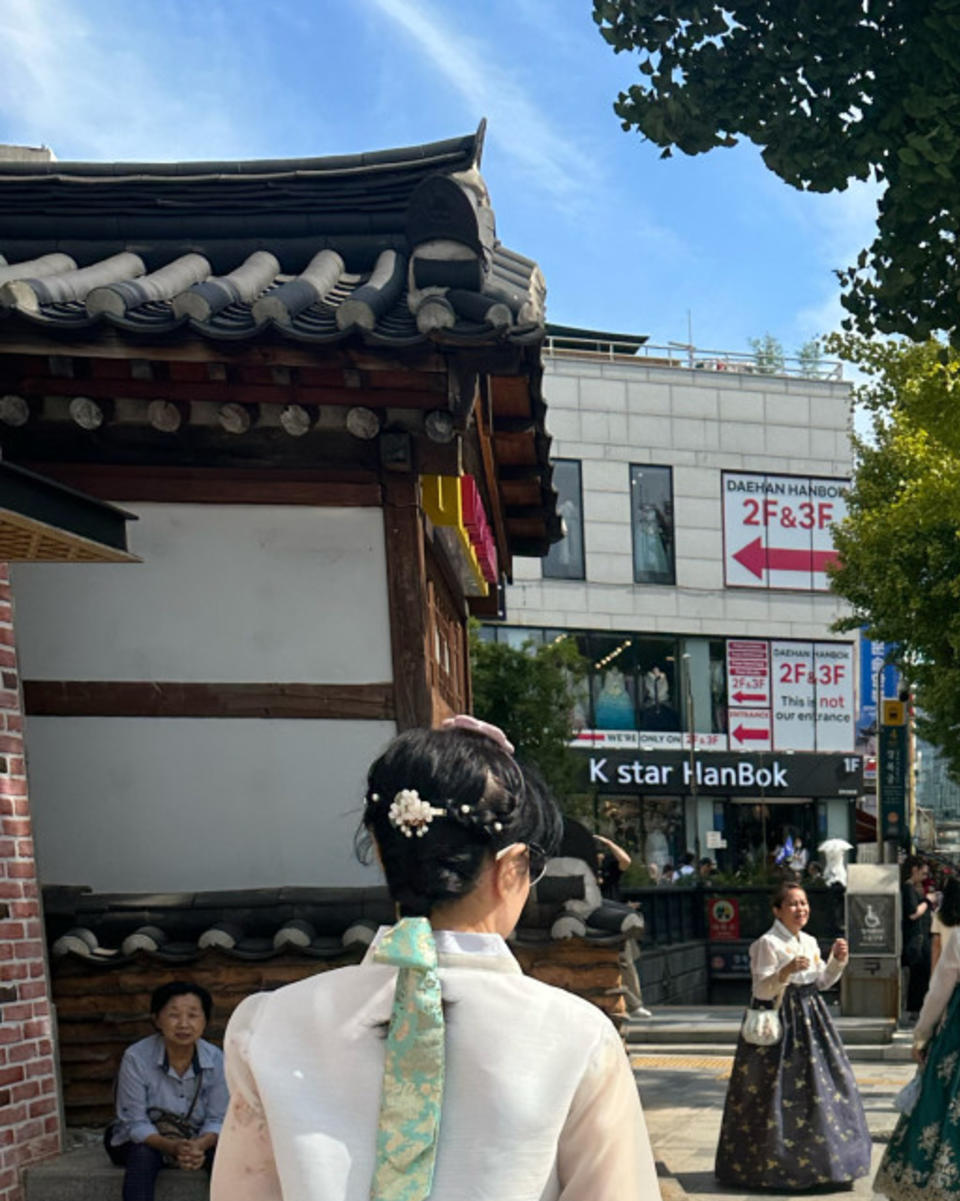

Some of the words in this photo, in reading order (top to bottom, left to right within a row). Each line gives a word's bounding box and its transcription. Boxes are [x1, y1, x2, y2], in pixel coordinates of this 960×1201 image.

[727, 479, 785, 495] DAEHAN
[781, 695, 805, 708] This
[820, 696, 845, 709] not
[776, 711, 795, 722] our
[798, 711, 851, 723] enrance
[641, 734, 664, 743] ONLY
[666, 735, 681, 744] ON
[589, 757, 609, 783] K
[617, 760, 673, 785] star
[682, 760, 788, 788] HanBok
[843, 758, 859, 773] 1F
